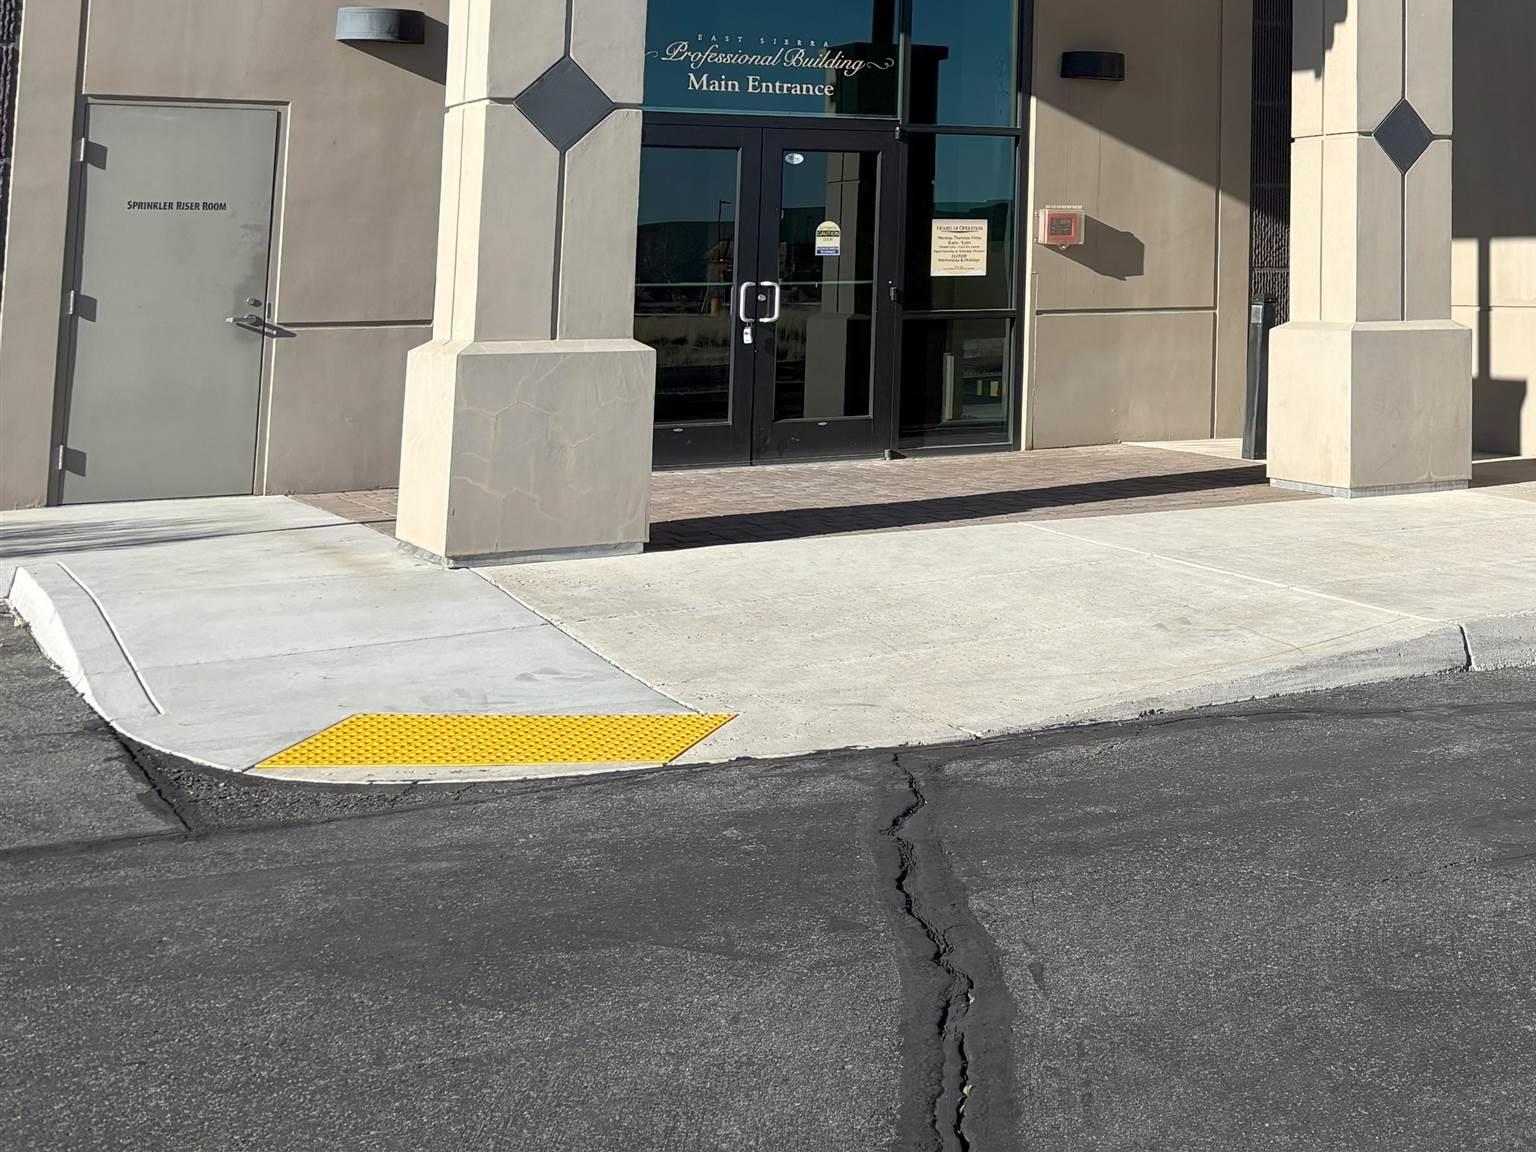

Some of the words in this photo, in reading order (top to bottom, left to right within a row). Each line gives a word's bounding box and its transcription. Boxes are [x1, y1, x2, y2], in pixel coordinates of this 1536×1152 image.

[697, 34, 743, 44] EAST
[759, 37, 830, 48] SIERRA
[661, 41, 783, 70] Professional
[783, 47, 867, 77] Building
[687, 73, 740, 93] Main
[746, 75, 835, 97] Entrance
[127, 200, 174, 211] SPRINKLER
[176, 201, 201, 211] RISER
[202, 201, 227, 211] ROOM
